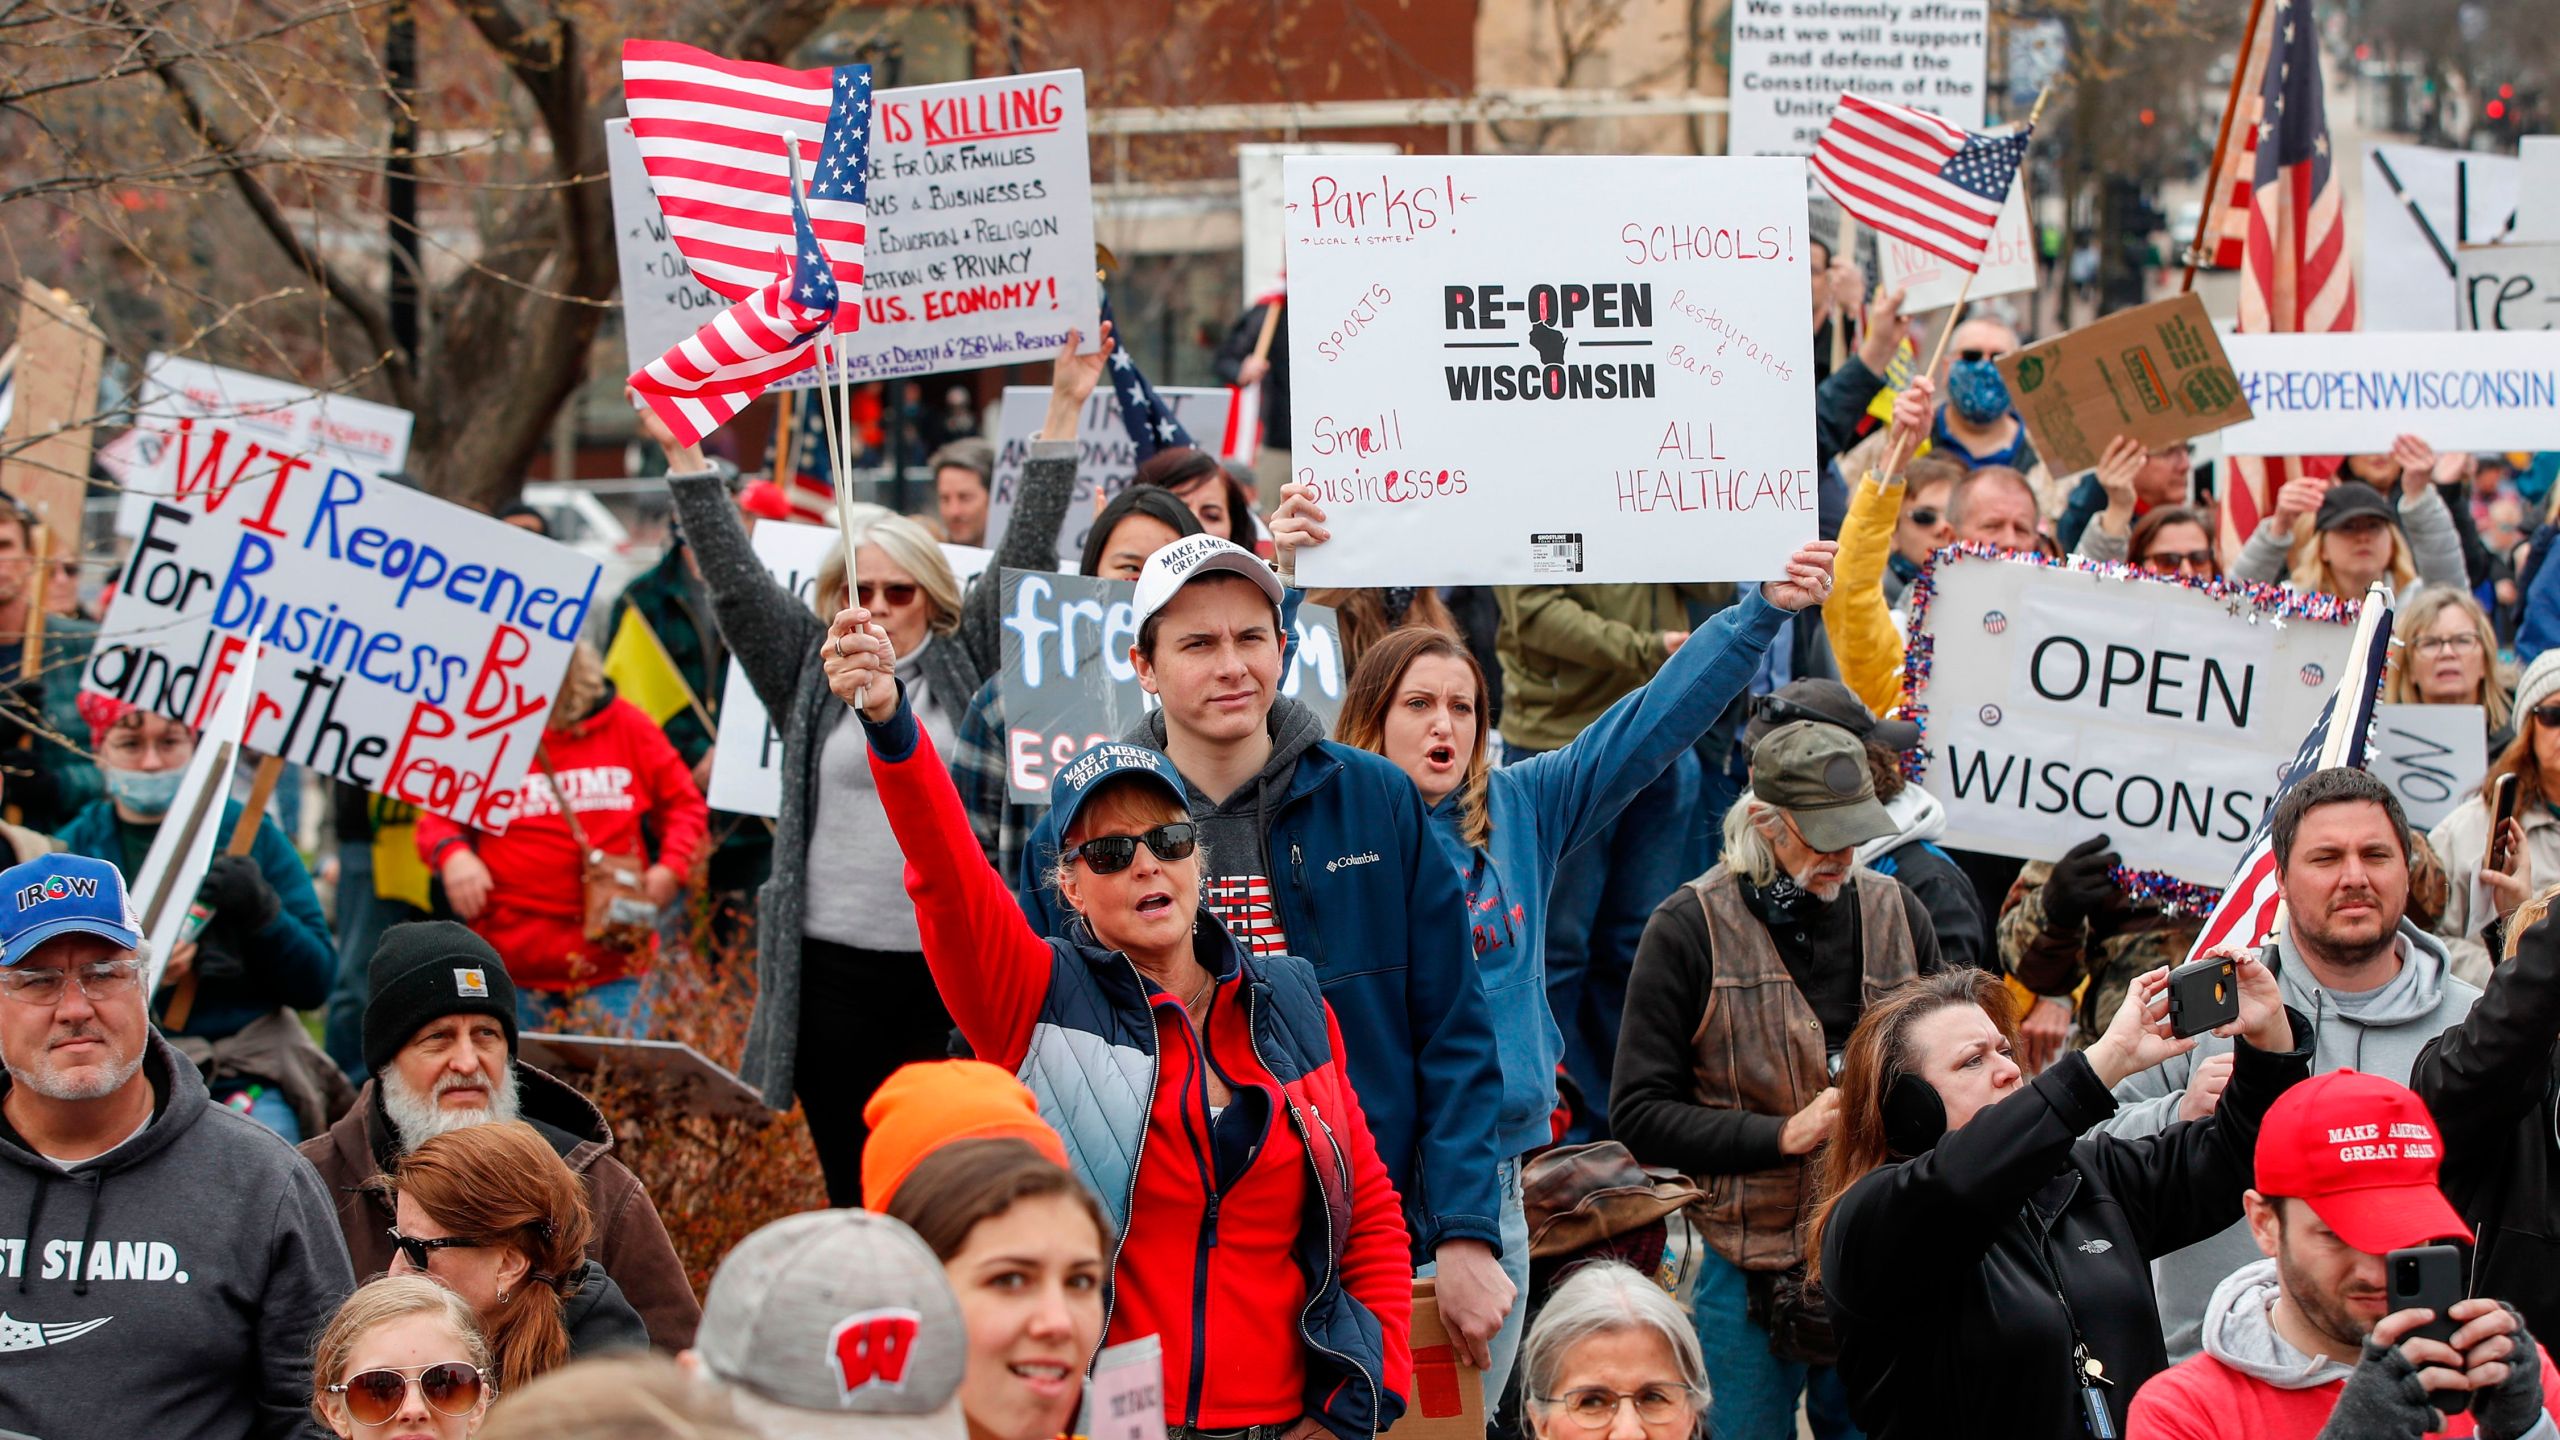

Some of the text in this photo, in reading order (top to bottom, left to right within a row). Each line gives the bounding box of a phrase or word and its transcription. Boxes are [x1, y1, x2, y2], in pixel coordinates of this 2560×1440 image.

[1747, 0, 1982, 22] We solemnly affirm
[1737, 25, 1982, 47] that we will support
[1768, 51, 1949, 70] and defend the
[1743, 73, 1973, 95] Constitution of the
[881, 84, 1063, 143] IS KILLING
[1774, 98, 1836, 116] Unite
[924, 150, 957, 175] OUR
[959, 145, 1036, 171] FAMILIES
[865, 197, 899, 218] RMS
[929, 179, 1047, 211] BUSINESSES
[1312, 175, 1456, 235] Parks!
[879, 227, 959, 254] EDUCATION
[973, 216, 1059, 243] RELIGION
[1313, 236, 1346, 245] LOCAL
[1367, 235, 1402, 244] STATE
[1622, 223, 1794, 265] SCHOOLS!
[862, 269, 922, 291] CTATION
[953, 247, 1032, 280] PRIVACY
[864, 297, 916, 323] U.S.
[1317, 283, 1391, 363] SPORTS
[1444, 283, 1654, 330] RE-OPEN
[1670, 289, 1792, 382] Restaurants
[1444, 364, 1656, 401] WISCONSIN
[1667, 345, 1724, 386] Bars
[2239, 370, 2555, 411] #REOPENWISCONSIN
[1311, 408, 1402, 458] Small
[1657, 421, 1726, 461] ALL
[1299, 466, 1468, 507] Businesses
[1615, 468, 1815, 514] HEALTHCARE
[173, 418, 602, 644] WI Reopened
[1160, 543, 1196, 568] MAKE
[123, 501, 548, 740] For Business By
[2030, 634, 2254, 728] OPEN
[92, 629, 214, 722] and
[191, 635, 283, 745] Fr
[382, 700, 516, 831] People
[1063, 745, 1161, 786] MAKE AMERICA
[1073, 756, 1156, 791] GREAT AGAIN
[1946, 743, 2272, 843] WISCONS
[1337, 851, 1380, 868] Columbia
[2328, 1122, 2433, 1144] MAKE AMERICA
[2339, 1143, 2436, 1162] GREAT AGAIN
[41, 1239, 189, 1284] STAND.
[825, 1307, 922, 1408] W
